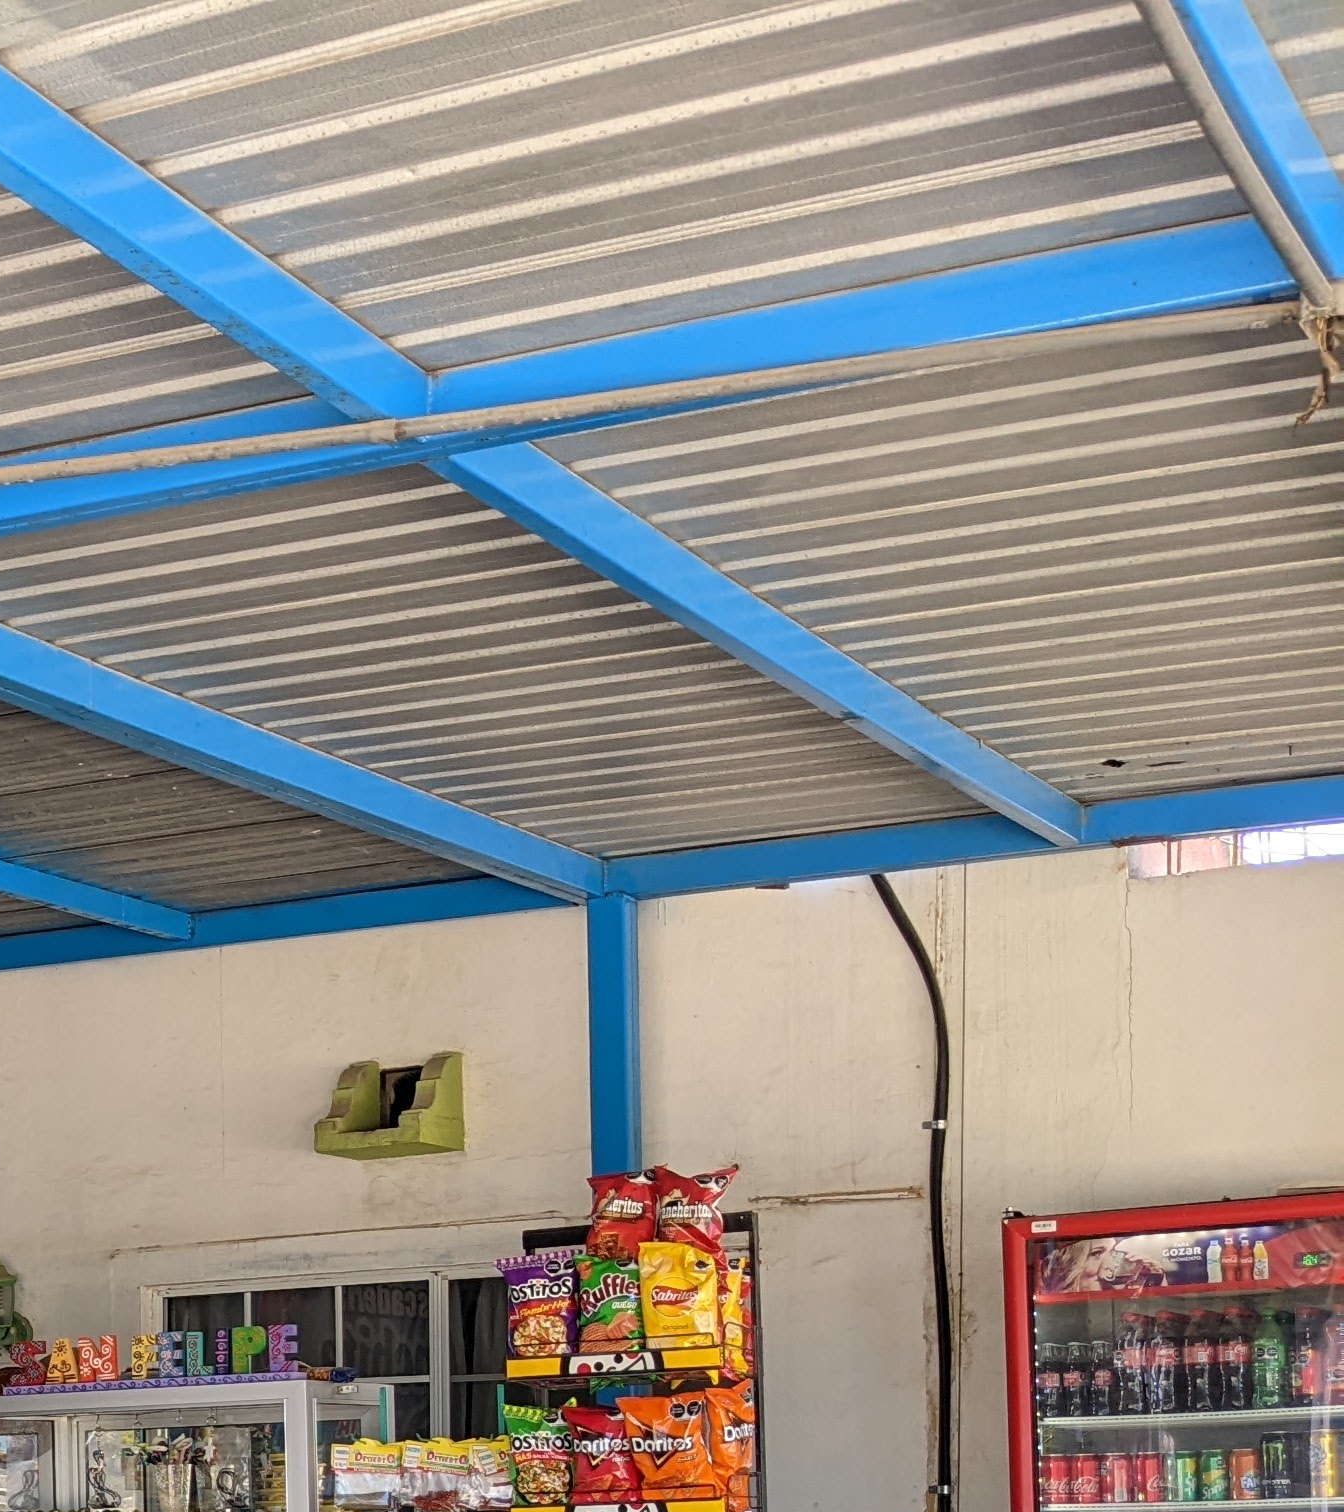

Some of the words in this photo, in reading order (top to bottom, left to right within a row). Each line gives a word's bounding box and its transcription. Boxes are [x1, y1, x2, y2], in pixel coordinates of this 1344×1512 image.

[660, 1201, 712, 1218] ancheritos
[509, 1278, 572, 1302] OSTITOS
[652, 1287, 698, 1302] Sabritas
[9, 1334, 118, 1386] SAN
[131, 1323, 300, 1381] FELIPE
[511, 1434, 571, 1451] OSTITOS
[574, 1439, 630, 1453] Doritos
[632, 1437, 692, 1453] Doritos
[1240, 1477, 1261, 1490] FAN
